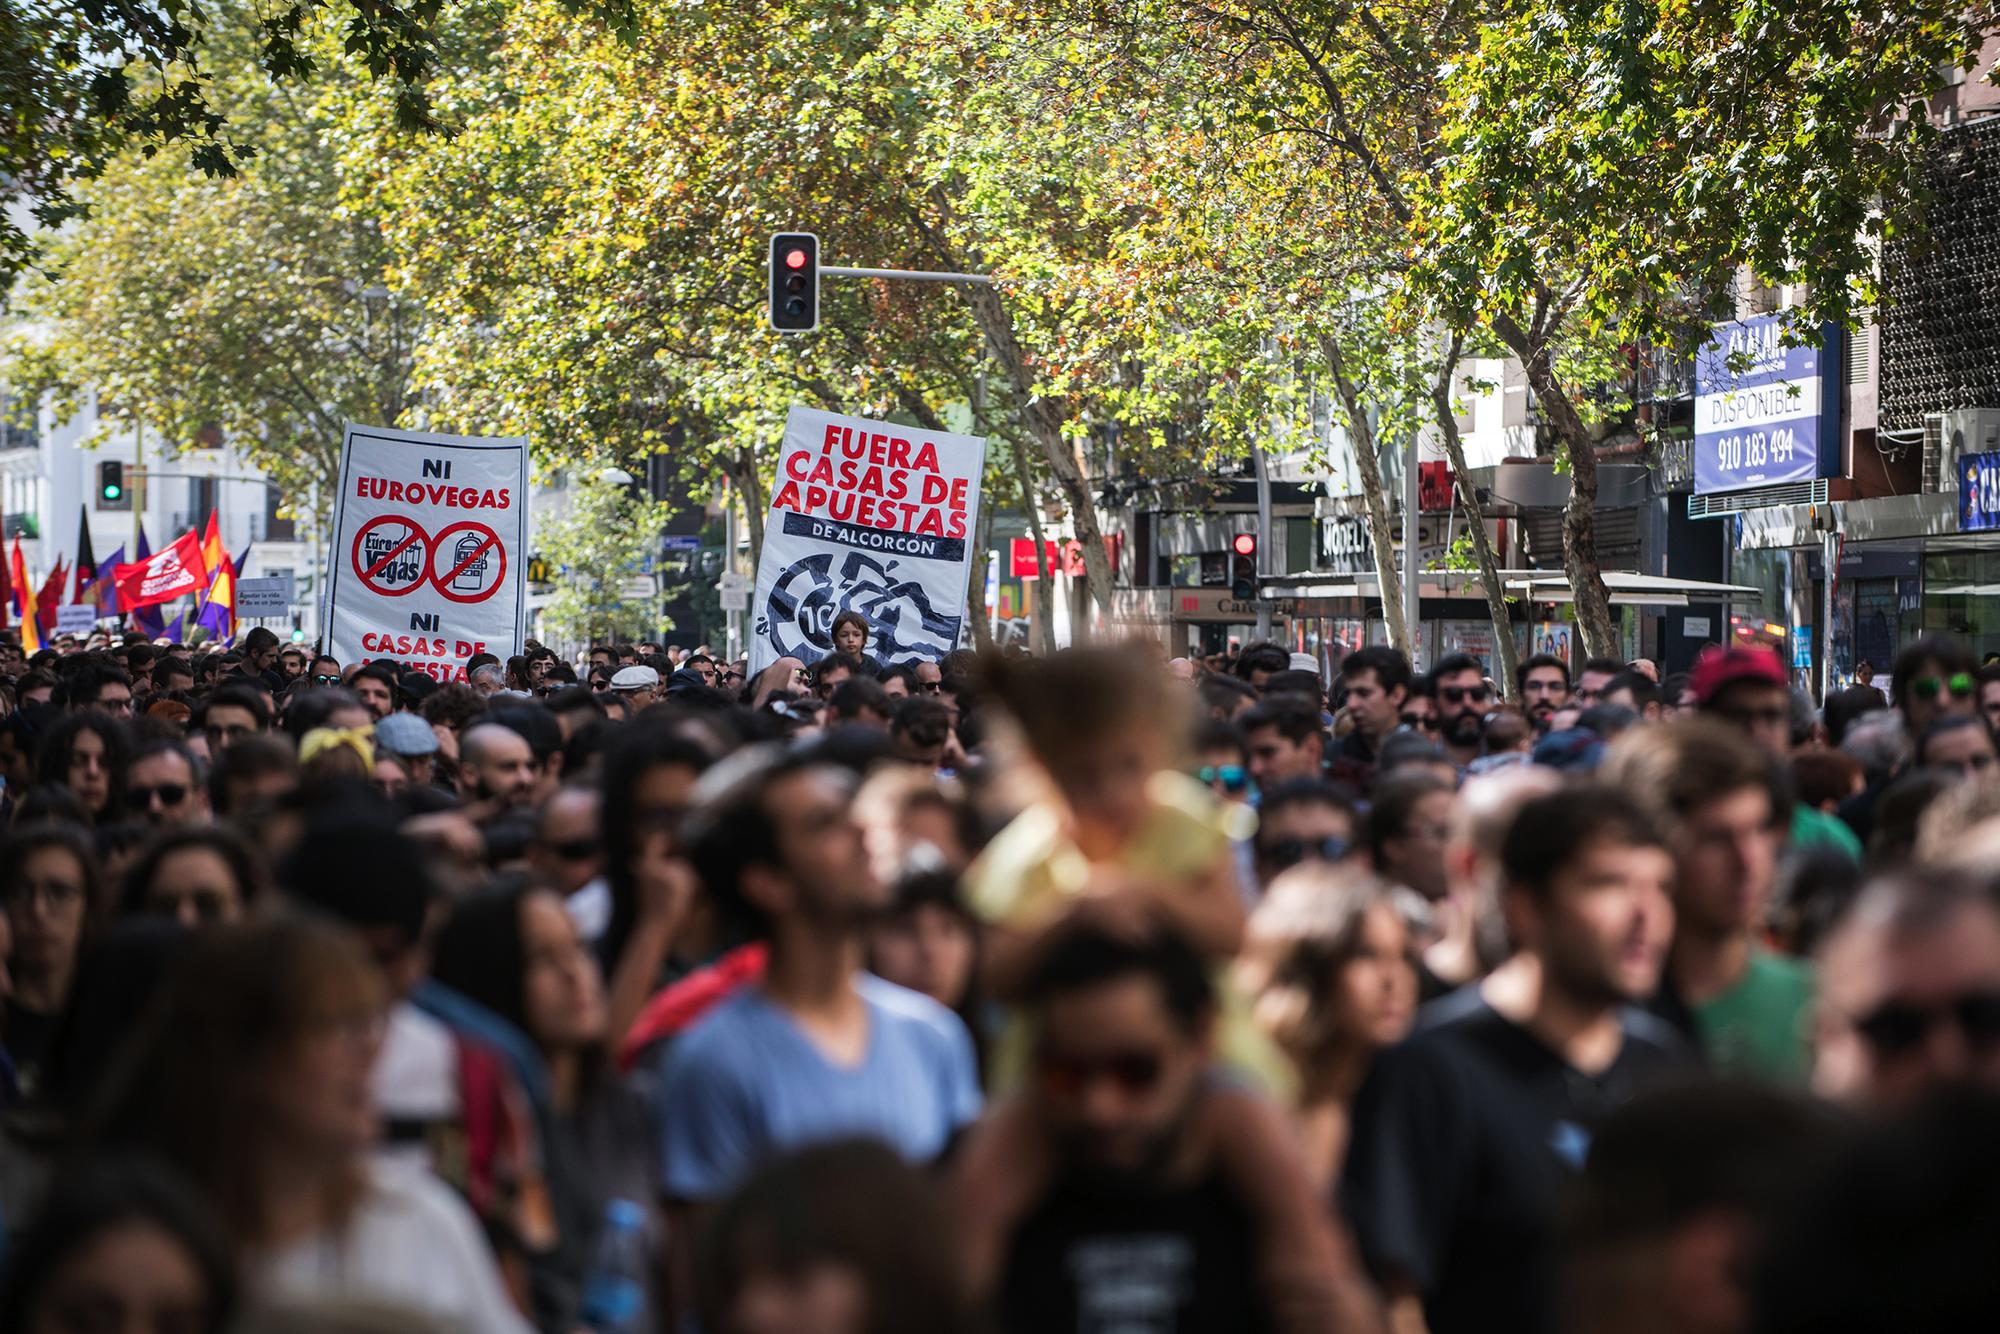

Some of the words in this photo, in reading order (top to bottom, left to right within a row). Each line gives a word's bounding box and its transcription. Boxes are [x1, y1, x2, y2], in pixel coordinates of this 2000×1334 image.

[1712, 386, 1802, 425] DISPONIBLE
[822, 424, 940, 473] FUERA
[1718, 436, 1741, 471] 910
[1745, 431, 1767, 467] 183
[1770, 427, 1793, 463] 494
[422, 458, 451, 480] NI
[785, 451, 908, 499] CASAS
[921, 474, 968, 510] DE
[357, 476, 510, 509] EUROVEGAS
[772, 480, 967, 539] APUESTAS
[365, 532, 393, 551] Euro
[812, 522, 833, 538] DE
[836, 527, 935, 555] ALCORCÓN
[410, 612, 439, 633] NI
[362, 632, 447, 657] CASAS
[455, 640, 486, 659] DE
